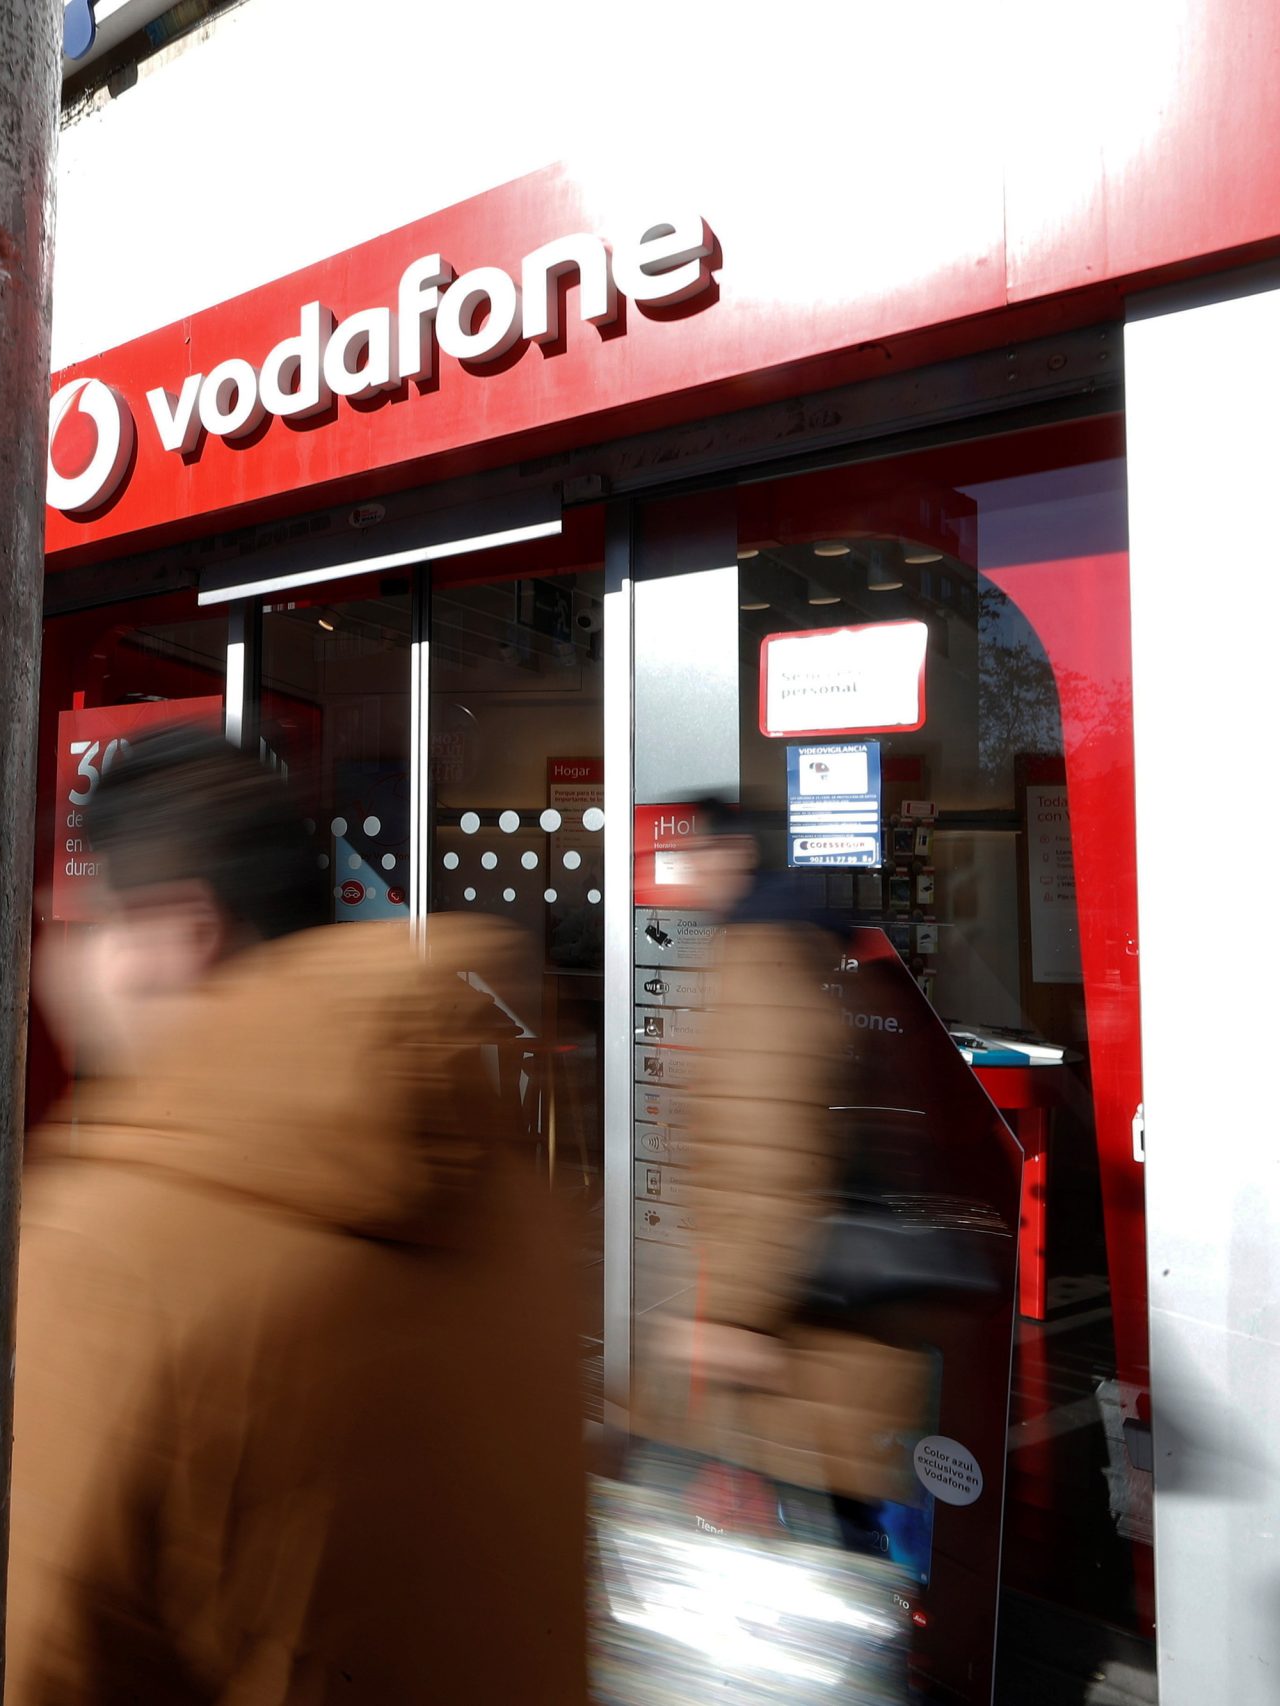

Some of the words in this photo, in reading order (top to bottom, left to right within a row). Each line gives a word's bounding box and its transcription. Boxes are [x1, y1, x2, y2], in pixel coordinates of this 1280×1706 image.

[146, 212, 716, 455] vodafone
[782, 682, 857, 699] personal
[798, 745, 868, 755] VIDEOVIGILANCIA
[554, 765, 591, 779] Hogar
[66, 810, 83, 828] de
[654, 815, 697, 840] ¡Hol
[65, 838, 82, 852] en
[677, 919, 697, 927] Zona
[924, 1446, 949, 1462] Color
[952, 1458, 973, 1472] azul
[918, 1456, 964, 1479] exclusivo
[966, 1475, 979, 1486] en
[925, 1467, 970, 1493] Vodafone
[695, 1515, 727, 1535] Tiend
[893, 1594, 910, 1610] Pro
